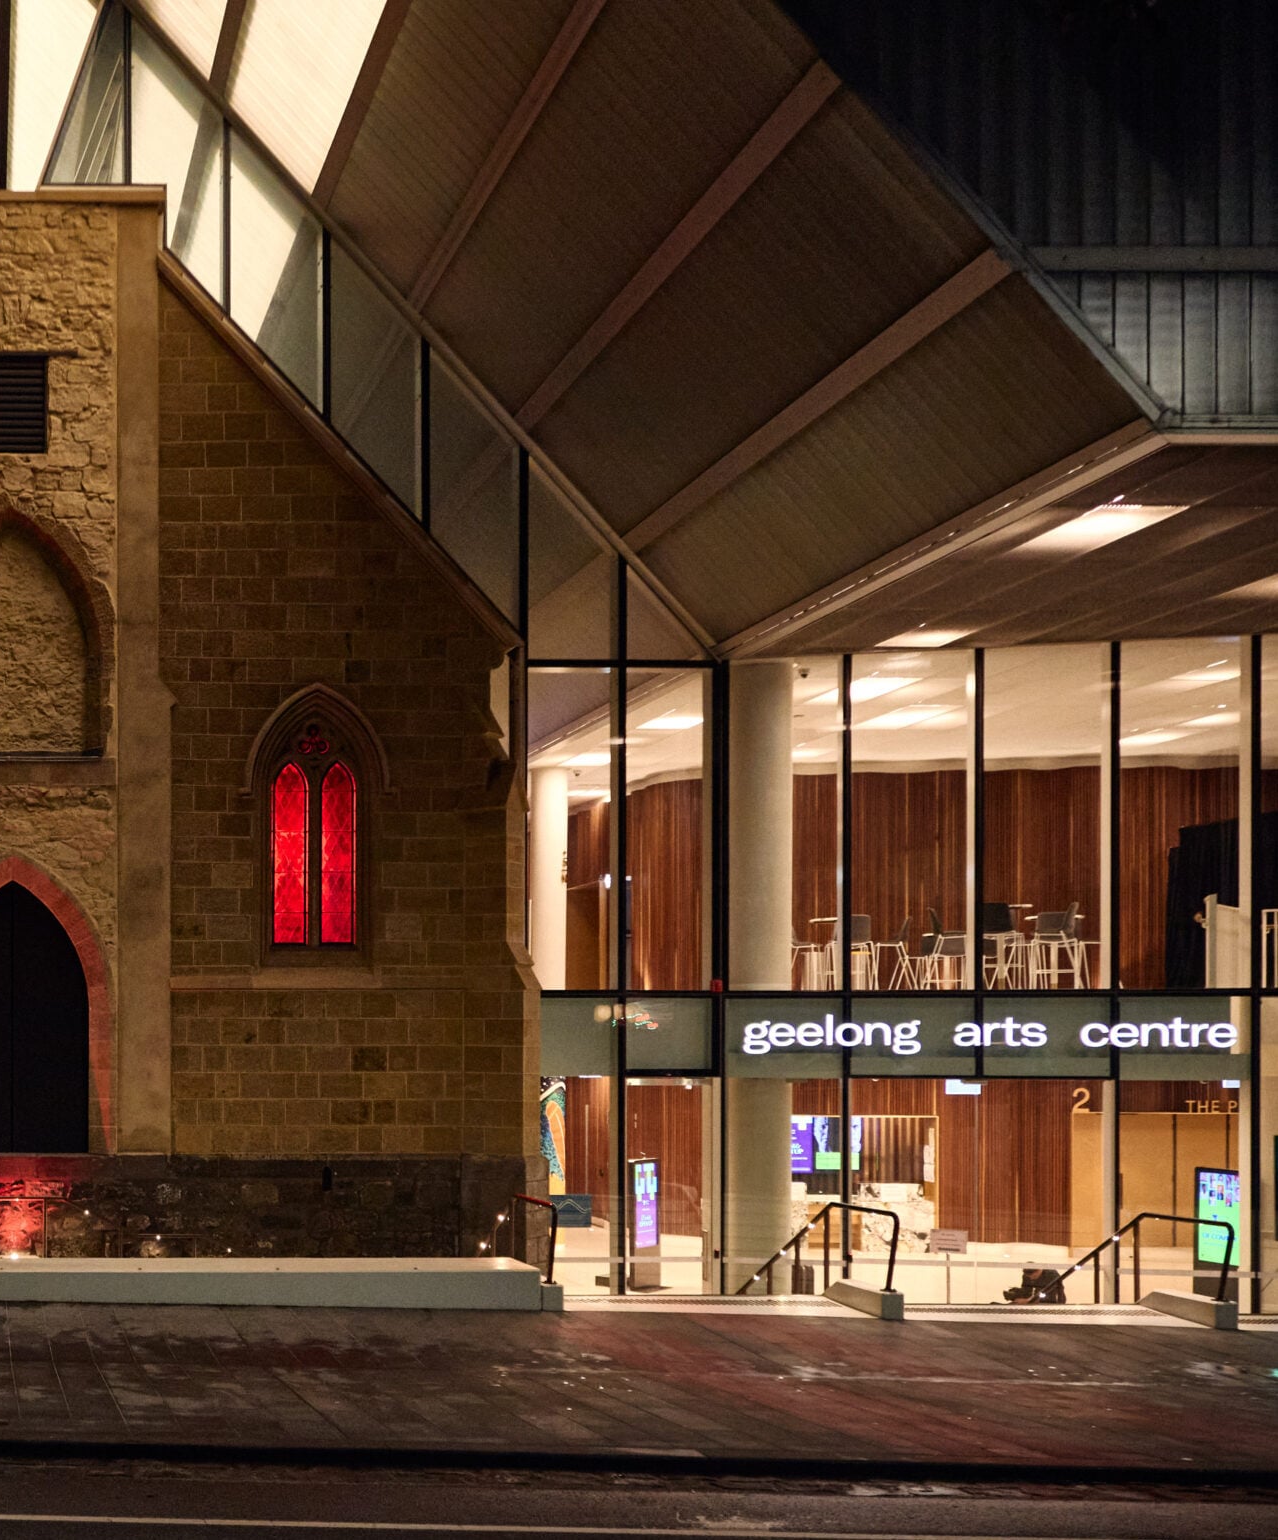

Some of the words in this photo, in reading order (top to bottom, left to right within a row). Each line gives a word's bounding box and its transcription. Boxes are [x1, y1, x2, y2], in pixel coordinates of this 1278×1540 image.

[742, 1013, 922, 1055] geelong
[953, 1017, 1048, 1048] arts
[1079, 1017, 1238, 1048] centre
[1072, 1087, 1091, 1113] 2
[1184, 1100, 1220, 1114] THE
